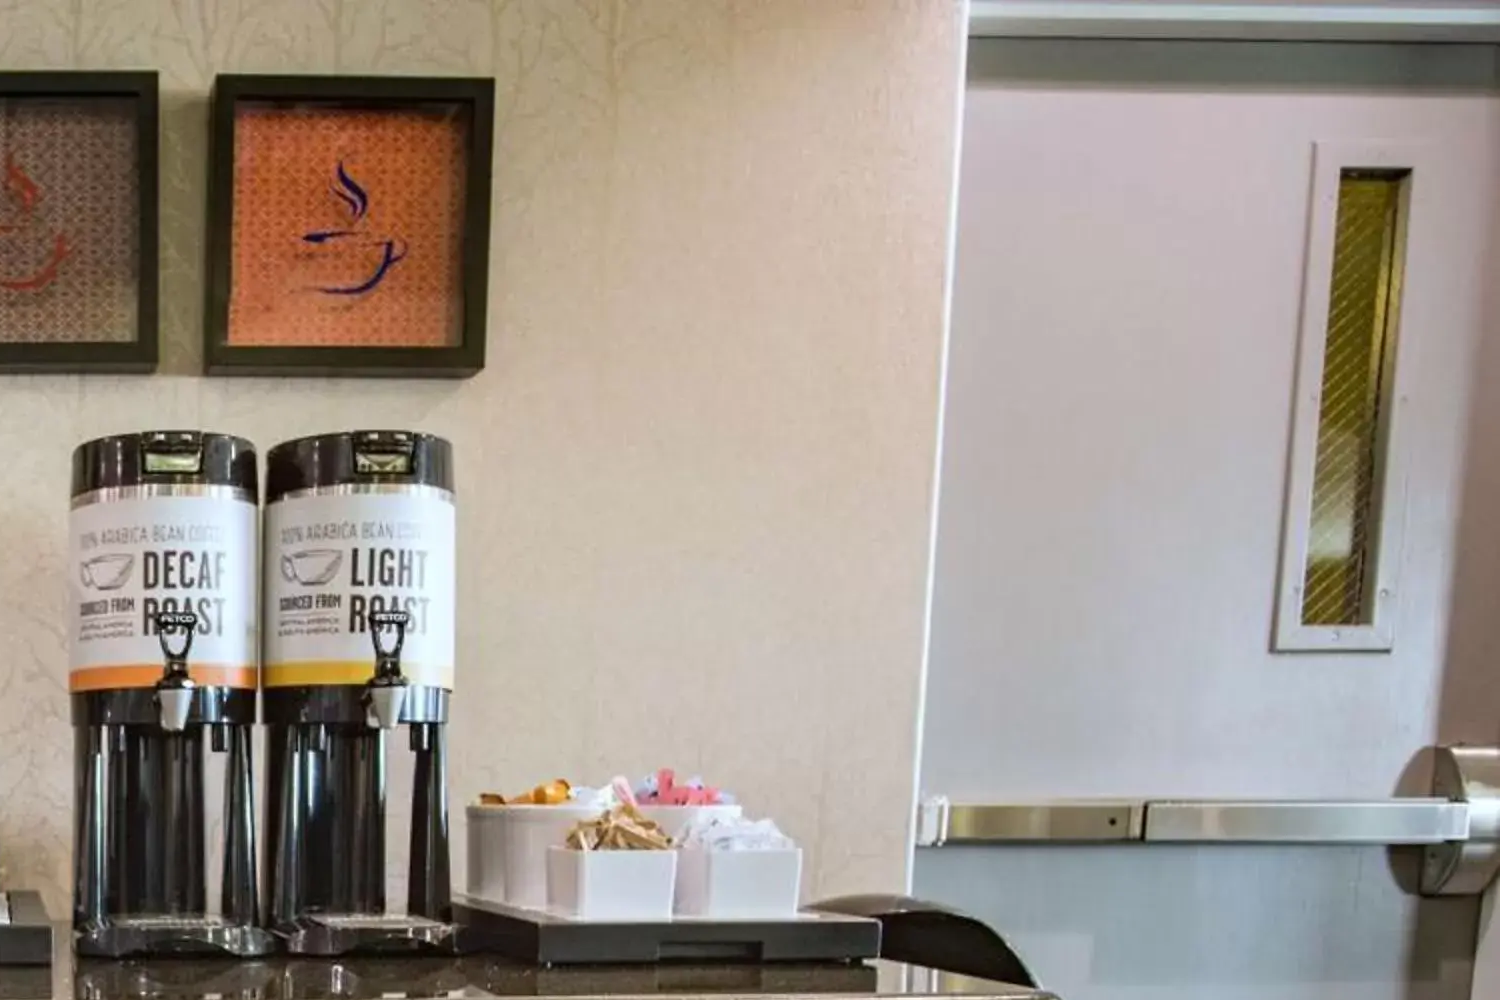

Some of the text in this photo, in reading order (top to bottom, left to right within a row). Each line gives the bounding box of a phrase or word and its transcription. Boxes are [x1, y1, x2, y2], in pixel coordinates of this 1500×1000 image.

[143, 549, 227, 591] DECAF
[351, 547, 429, 589] LIGHT
[143, 596, 227, 637] ROAST
[161, 615, 196, 623] FETCO
[348, 594, 431, 635] ROAST
